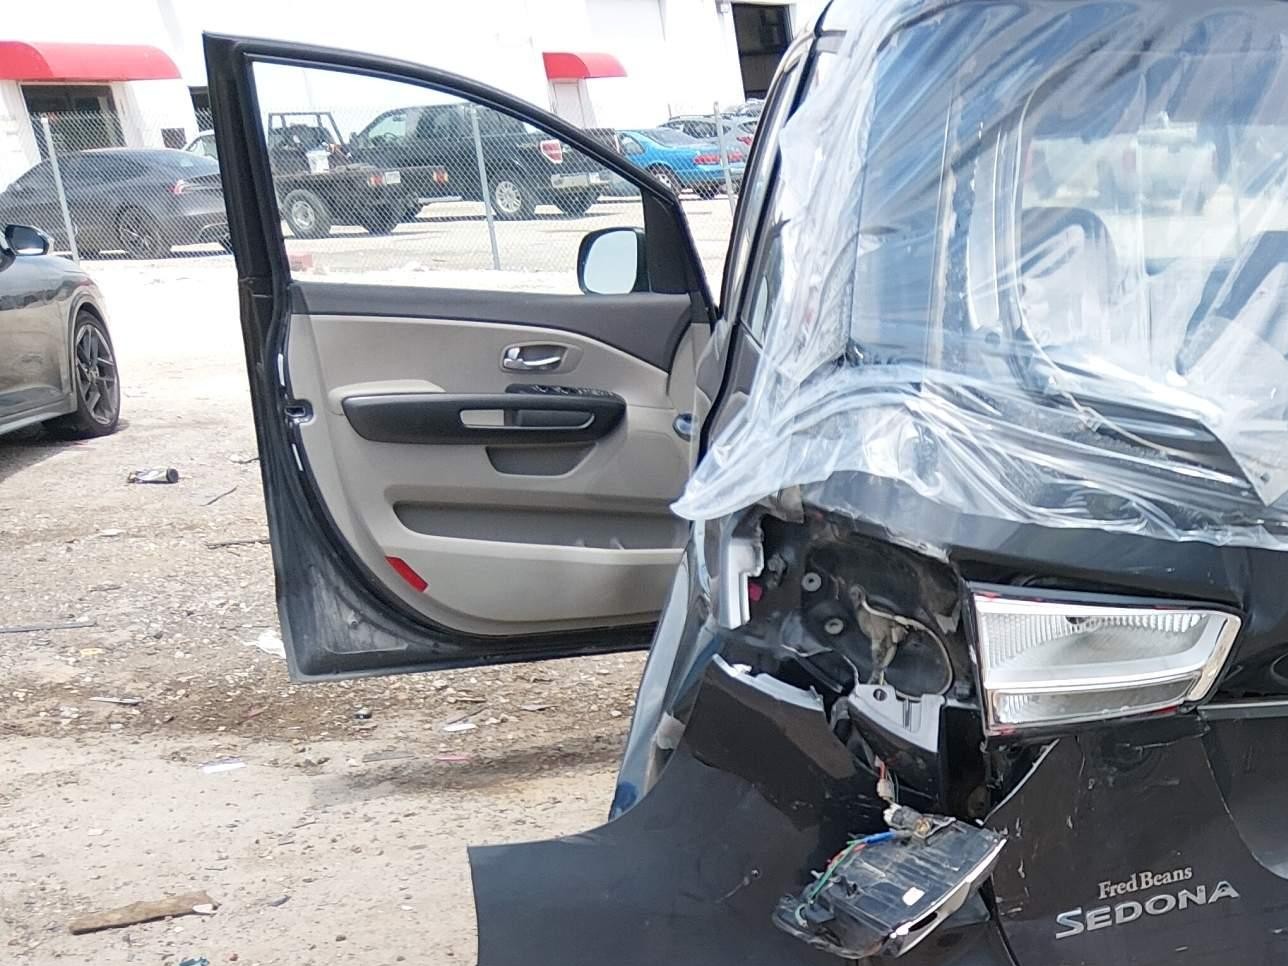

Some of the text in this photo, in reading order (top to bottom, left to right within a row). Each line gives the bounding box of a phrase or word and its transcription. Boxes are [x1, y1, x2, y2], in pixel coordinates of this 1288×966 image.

[1098, 865, 1193, 900] Fred Beans
[1055, 880, 1240, 939] SEDONA
